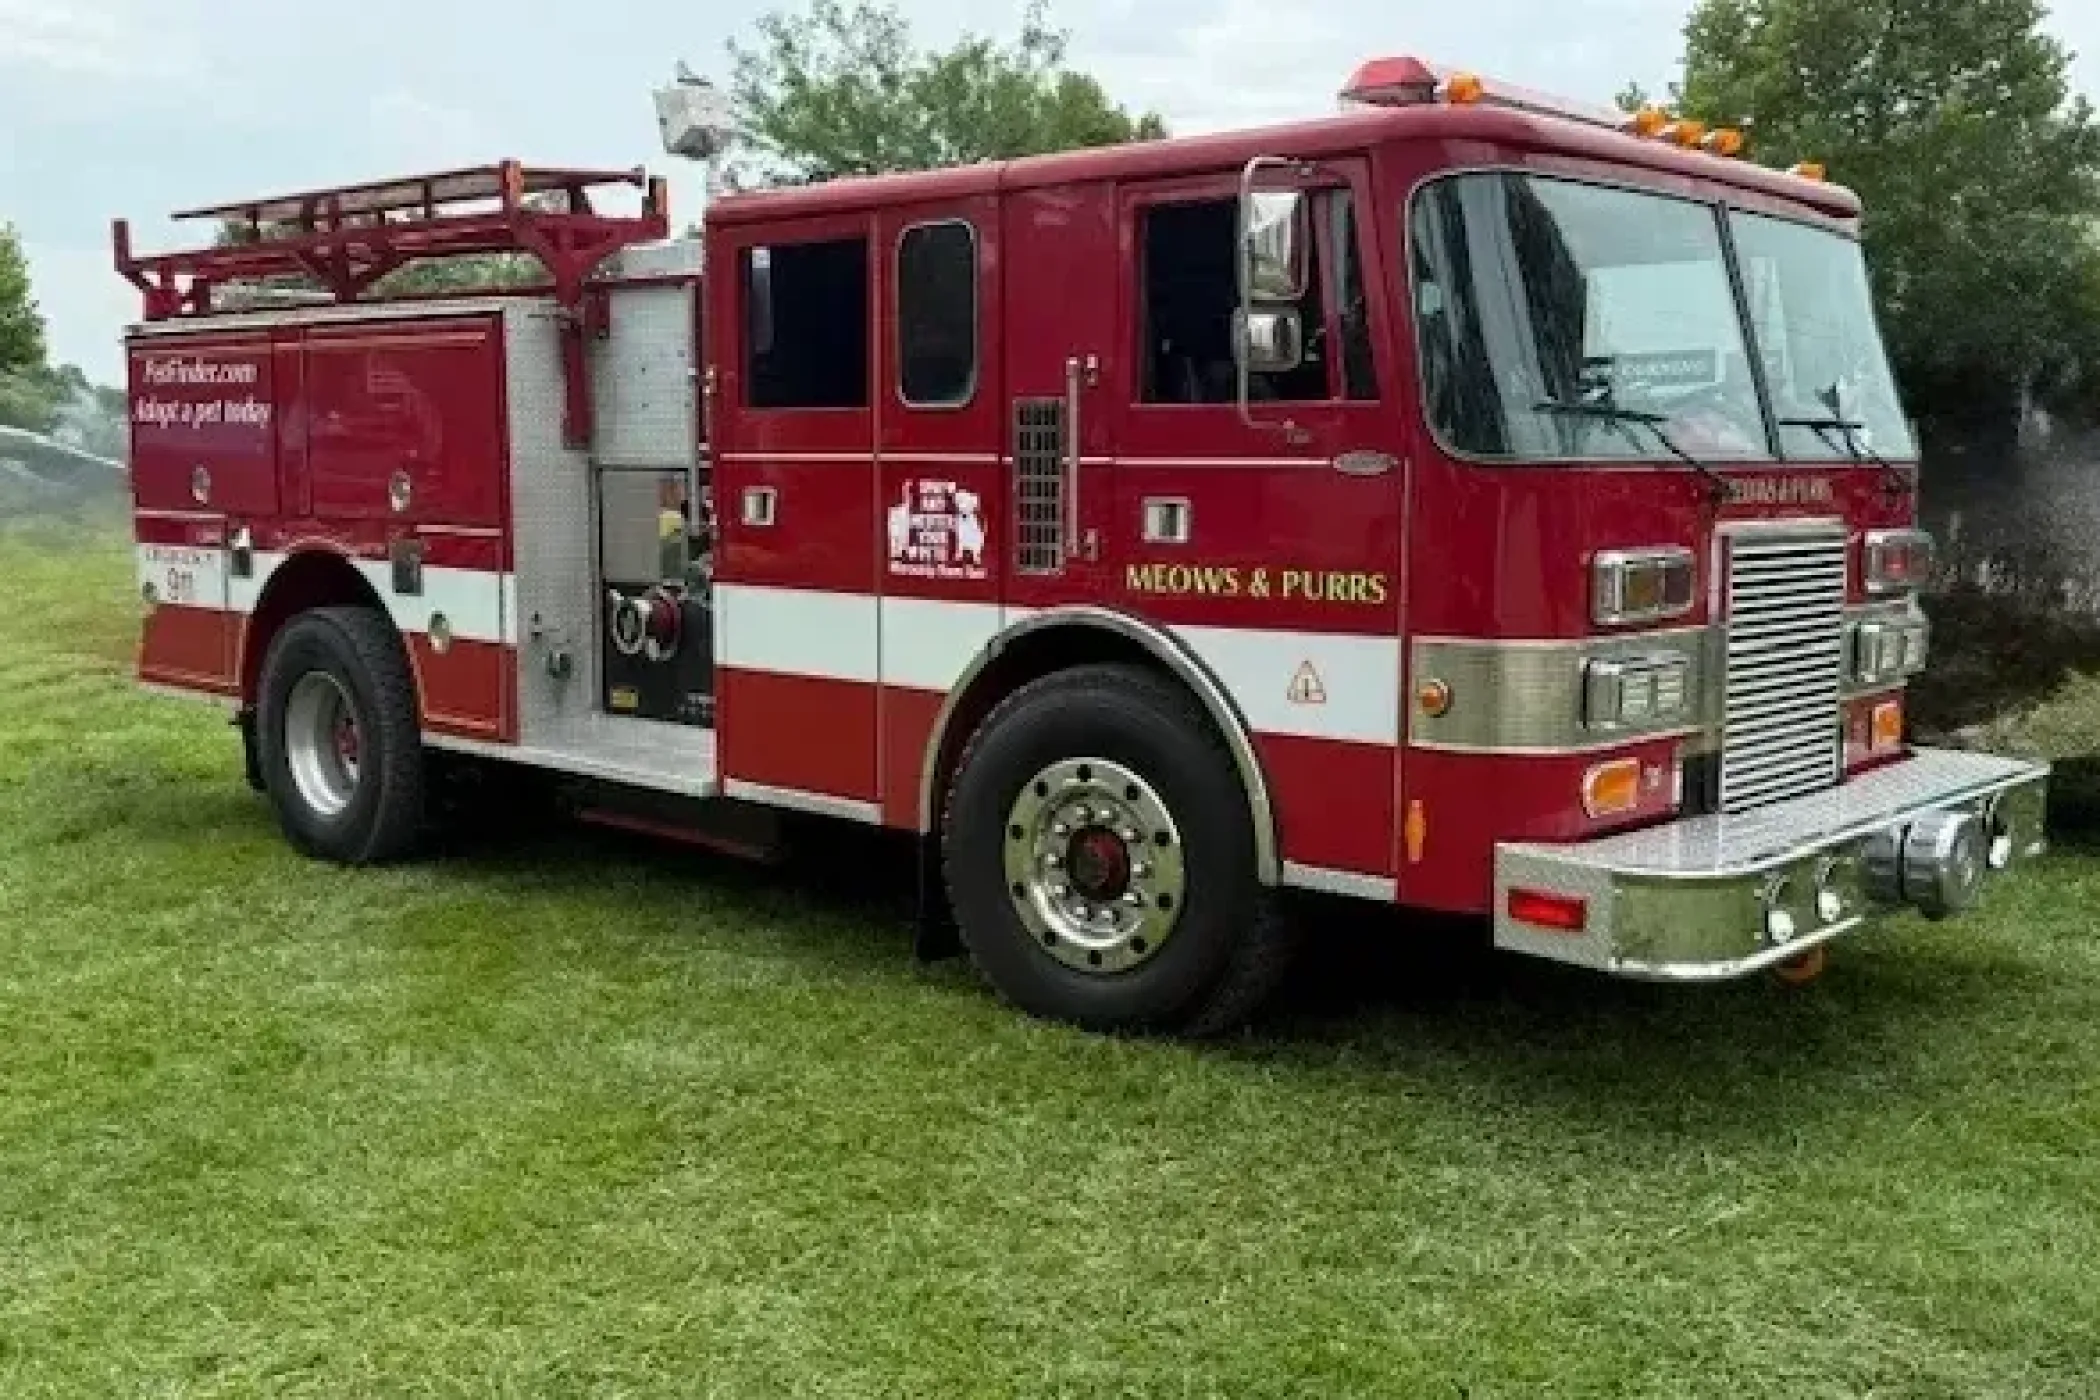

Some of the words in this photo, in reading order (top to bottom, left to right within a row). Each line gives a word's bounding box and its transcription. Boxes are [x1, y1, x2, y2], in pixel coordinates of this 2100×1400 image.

[136, 393, 179, 429] Adopt
[193, 399, 222, 429] pet
[224, 393, 272, 429] today
[1125, 563, 1239, 595] MEOWS
[1247, 567, 1271, 600] &
[1281, 569, 1388, 605] PURRS
